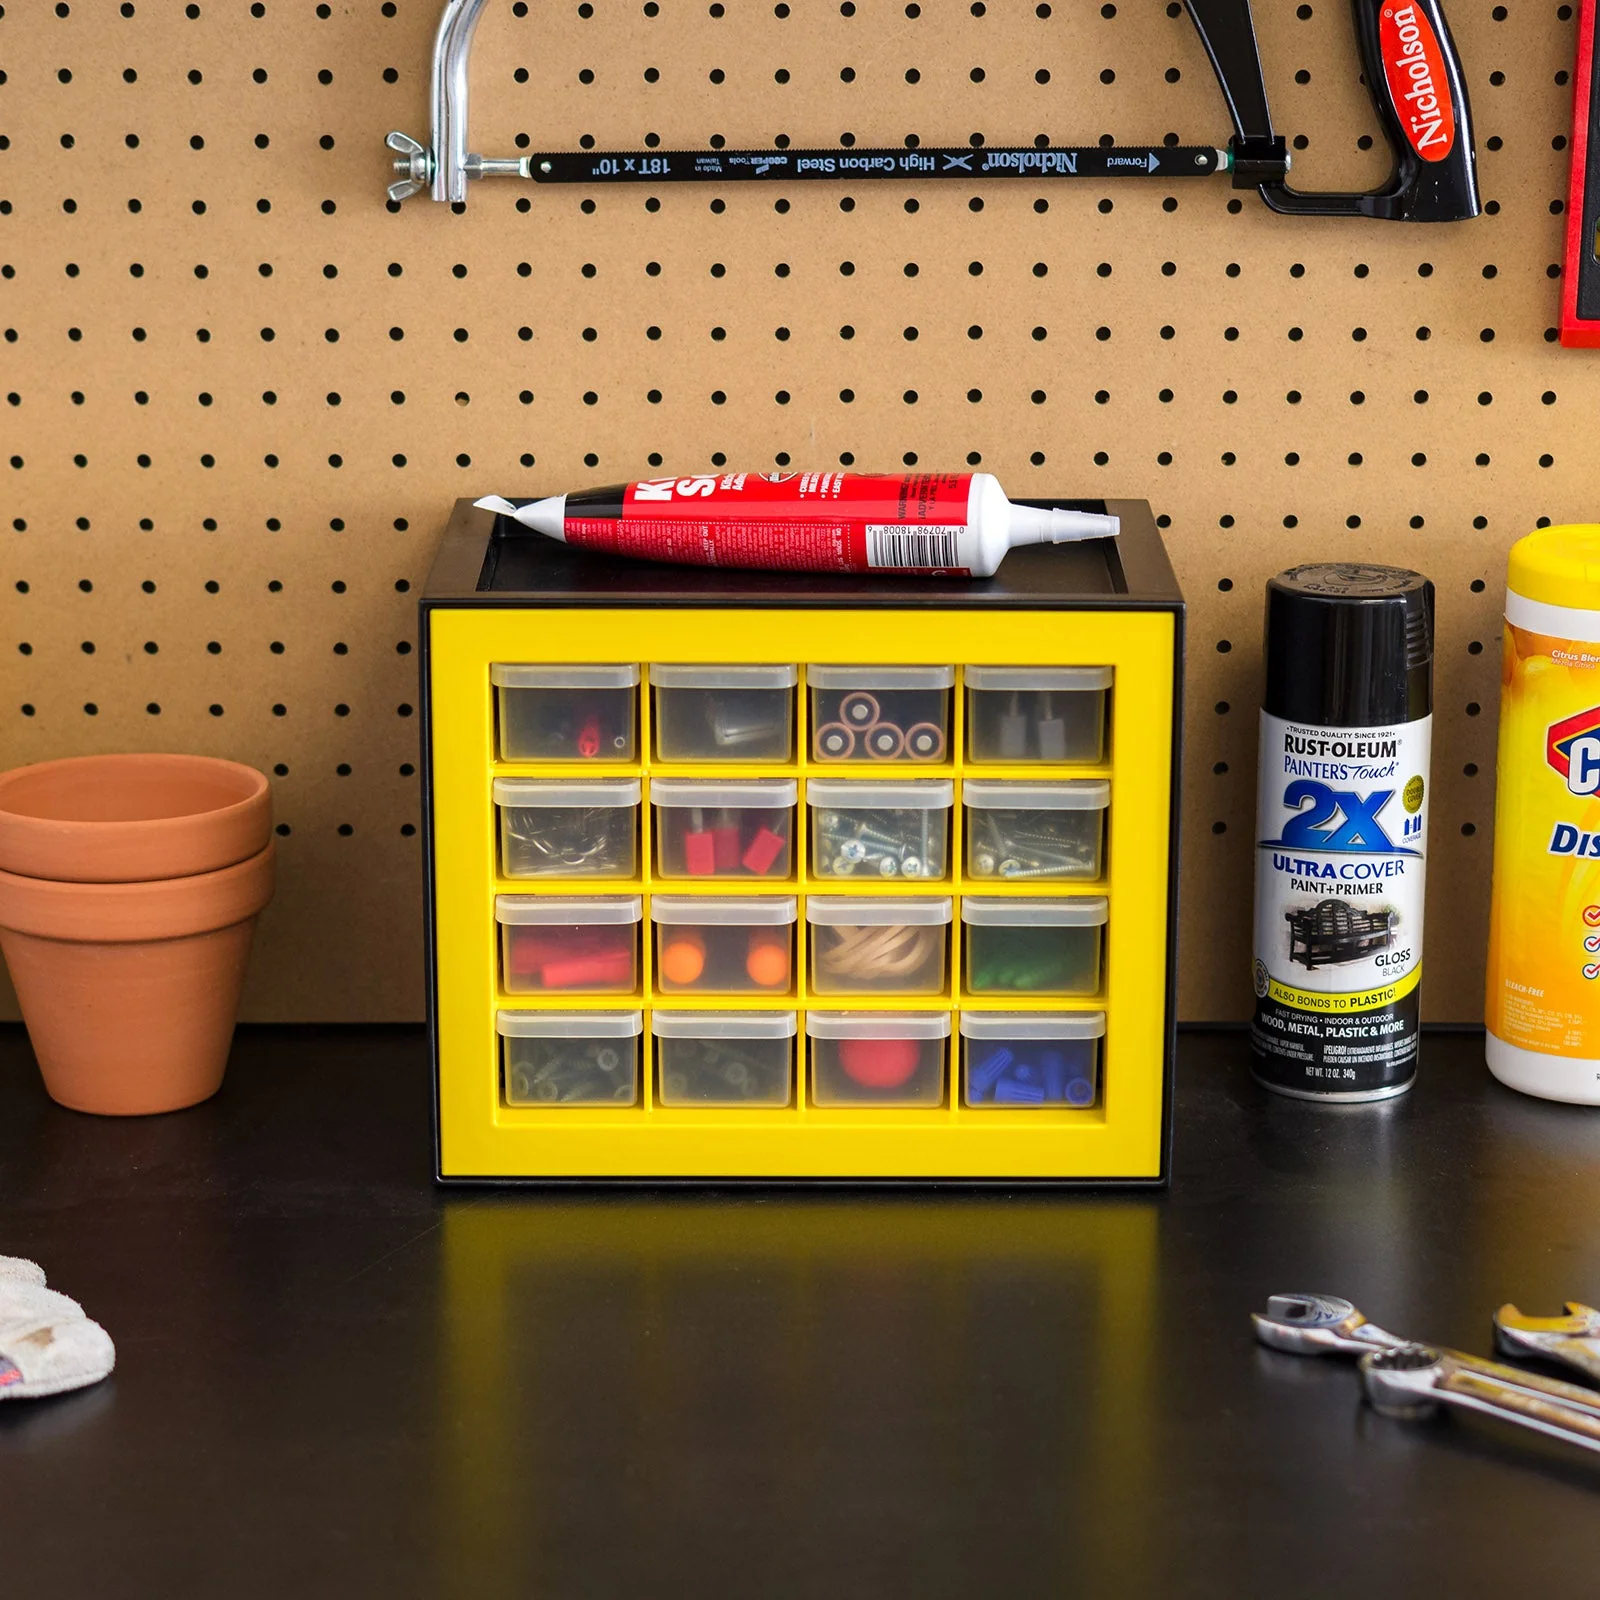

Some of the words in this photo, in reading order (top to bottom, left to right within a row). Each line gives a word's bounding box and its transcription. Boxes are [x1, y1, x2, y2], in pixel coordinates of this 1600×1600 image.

[1395, 6, 1447, 151] Nicholson
[592, 159, 620, 174] 10"
[624, 159, 635, 171] x
[639, 158, 670, 174] 18T
[797, 158, 835, 173] Steel
[840, 156, 895, 173] Carbon
[900, 156, 935, 170] High
[987, 152, 1077, 173] Nicholson
[1107, 157, 1147, 168] Forward
[883, 526, 911, 534] 18008
[917, 526, 946, 534] 70798
[1552, 650, 1578, 660] Citrus
[1290, 726, 1319, 736] TRUSTED
[1321, 730, 1352, 739] QUALITY
[1285, 734, 1397, 758] RUST-OLEUM
[1285, 756, 1348, 780] PAINTER'S
[1349, 761, 1394, 779] Touch
[1282, 779, 1396, 852] 2X
[1375, 948, 1411, 967] GLOSS
[1383, 965, 1405, 976] BLACK
[1274, 987, 1295, 1003] ALSO
[1297, 996, 1330, 1008] BONDS
[1334, 1000, 1346, 1008] TO
[1350, 990, 1396, 1007] PLASTIC!
[1275, 1009, 1290, 1018] FAST
[1292, 1013, 1318, 1023] DRYING
[1362, 1014, 1393, 1024] OUTDOOR
[1261, 1014, 1287, 1031] WOOD,
[1288, 1023, 1324, 1038] METAL,
[1326, 1026, 1369, 1037] PLASTIC
[1370, 1026, 1379, 1036] &
[1380, 1020, 1403, 1034] MORE
[1306, 1067, 1314, 1075] NET
[1315, 1068, 1324, 1077] WT.
[1325, 1069, 1331, 1077] 12
[1332, 1069, 1340, 1078] OZ.
[1343, 1068, 1356, 1080] 340g
